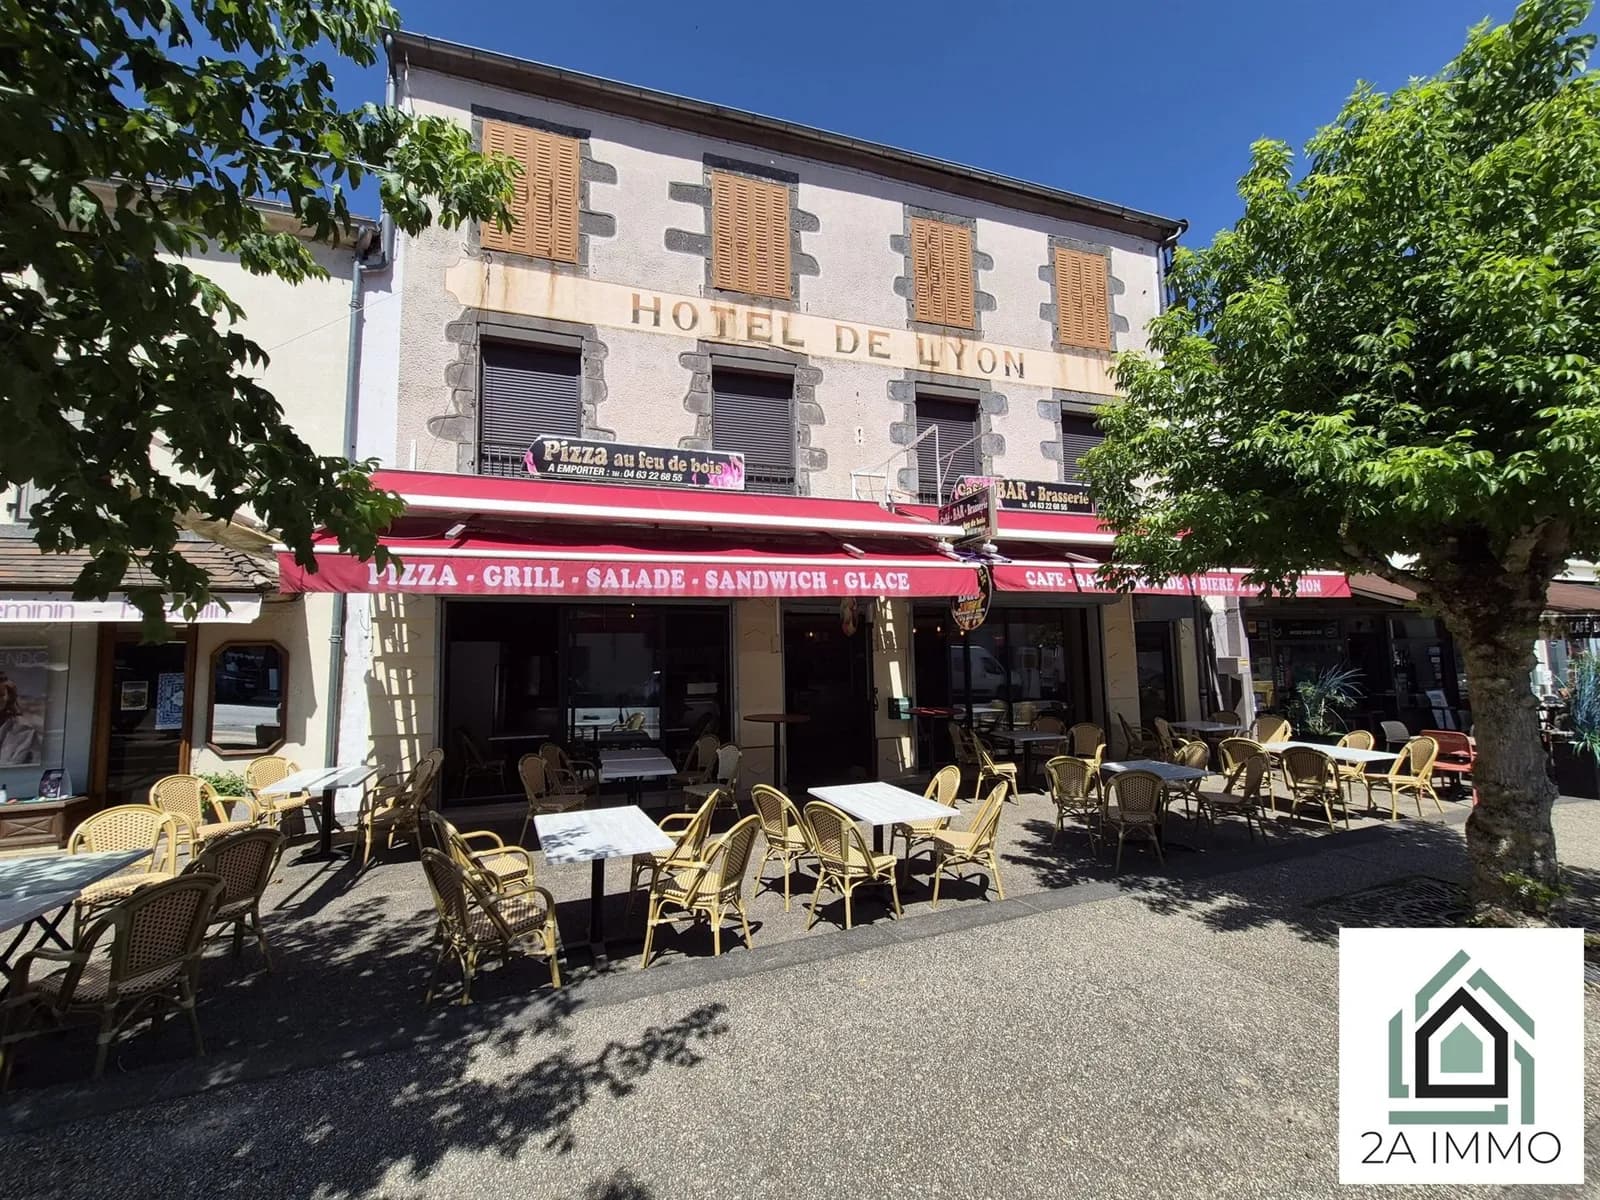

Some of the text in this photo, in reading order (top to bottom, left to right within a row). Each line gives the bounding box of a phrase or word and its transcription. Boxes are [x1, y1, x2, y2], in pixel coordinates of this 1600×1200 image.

[631, 293, 1025, 379] HOTEL DE LYON
[543, 440, 722, 475] Pizza au feu de bois
[547, 463, 555, 473] A
[557, 463, 605, 476] EMPORTER
[624, 469, 635, 478] 04
[636, 470, 647, 479] 63
[648, 471, 659, 480] 22
[660, 472, 671, 481] 68
[672, 473, 683, 482] 55
[995, 481, 1028, 501] BAR
[482, 565, 564, 588] GRILL
[586, 567, 685, 589] SALADE
[704, 569, 827, 590] SANDWICH
[844, 571, 910, 591] GLACE
[1025, 570, 1065, 587] CAFE
[1200, 577, 1234, 592] BIERE
